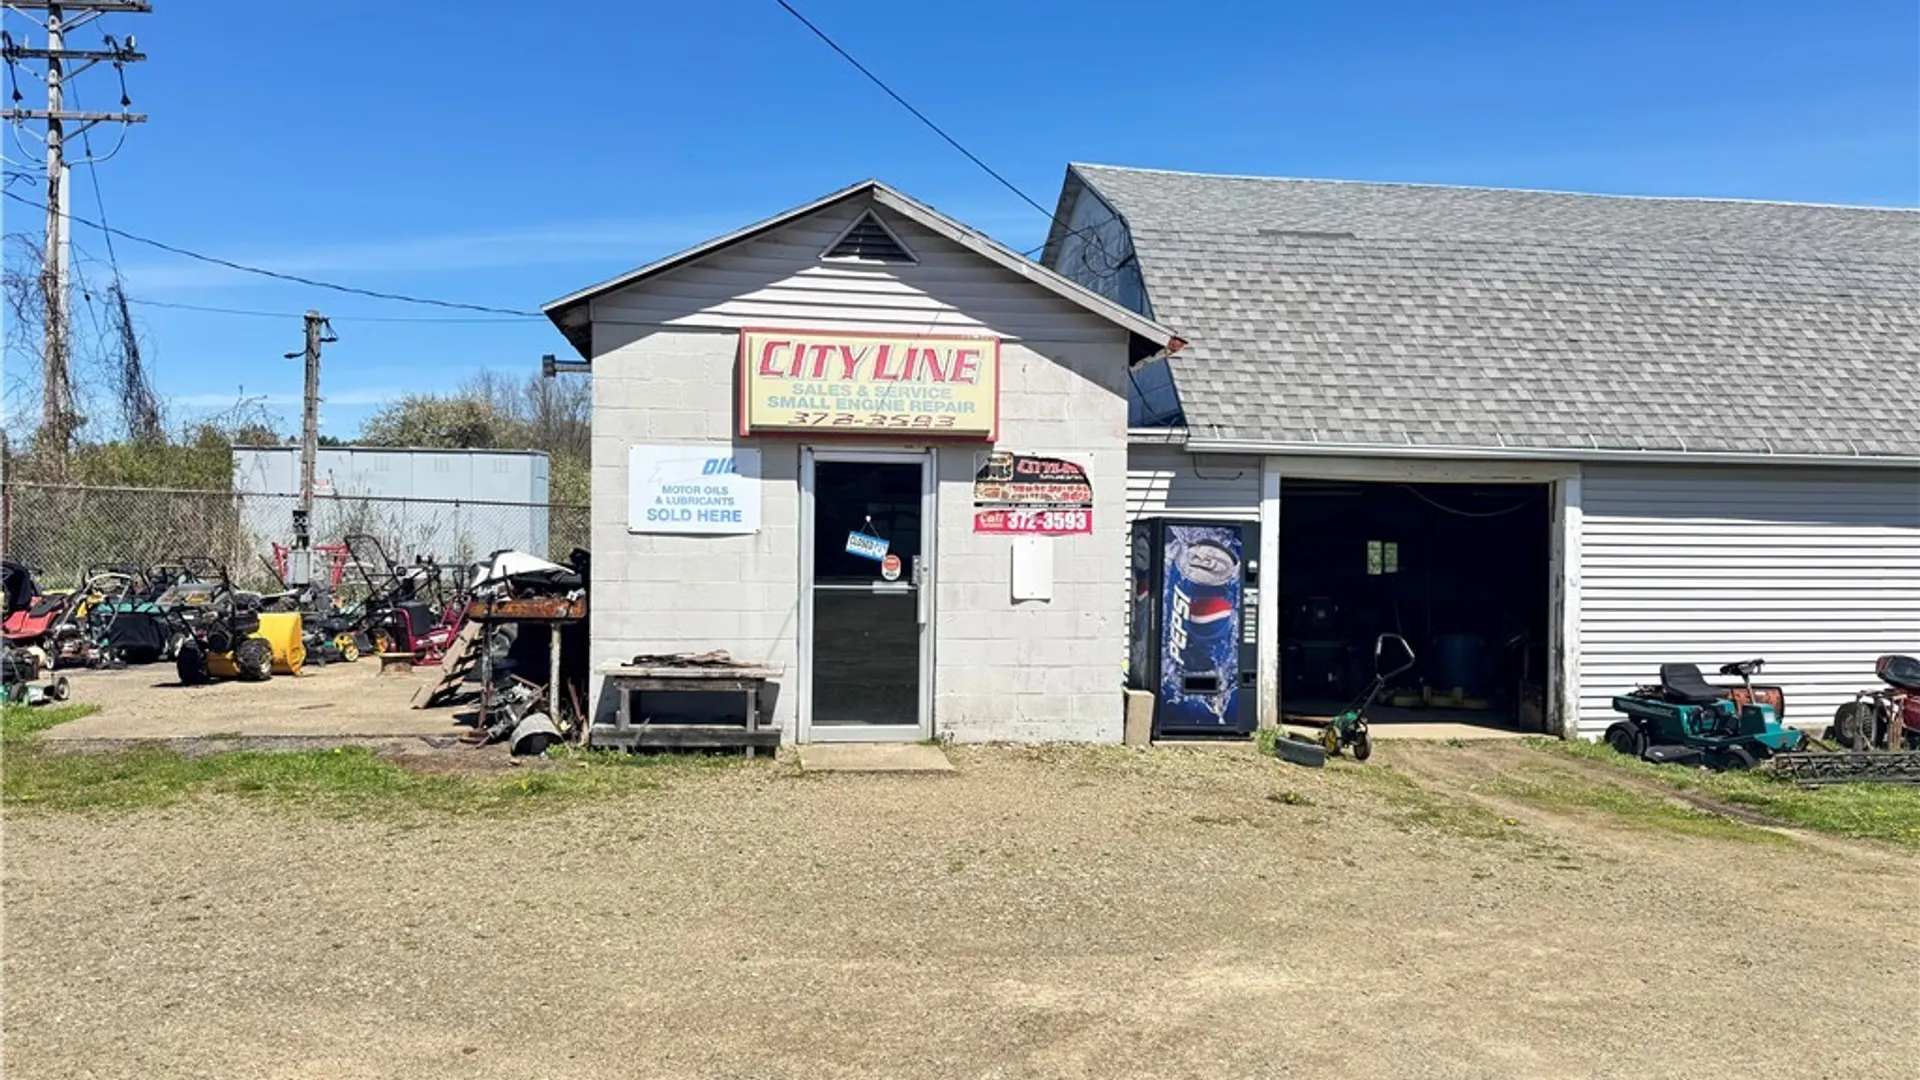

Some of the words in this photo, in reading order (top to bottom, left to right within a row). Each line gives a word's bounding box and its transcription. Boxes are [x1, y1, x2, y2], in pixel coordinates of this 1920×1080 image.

[758, 340, 869, 381] CITY
[872, 344, 981, 384] LINE
[792, 383, 852, 397] SALES
[858, 385, 869, 398] &
[875, 386, 952, 399] SERVICE
[766, 396, 830, 411] SMALL
[836, 398, 906, 412] ENGINE
[909, 400, 976, 413] REPAIR
[786, 412, 957, 429] 372-3593
[661, 485, 701, 495] MOTOR
[703, 485, 729, 496] OILS
[654, 496, 663, 505] &
[665, 496, 735, 507] LUBRICANTS
[646, 507, 692, 522] SOLD
[697, 509, 743, 523] HERE
[1007, 511, 1087, 530] 372-3593
[1169, 583, 1192, 666] PEPSI
